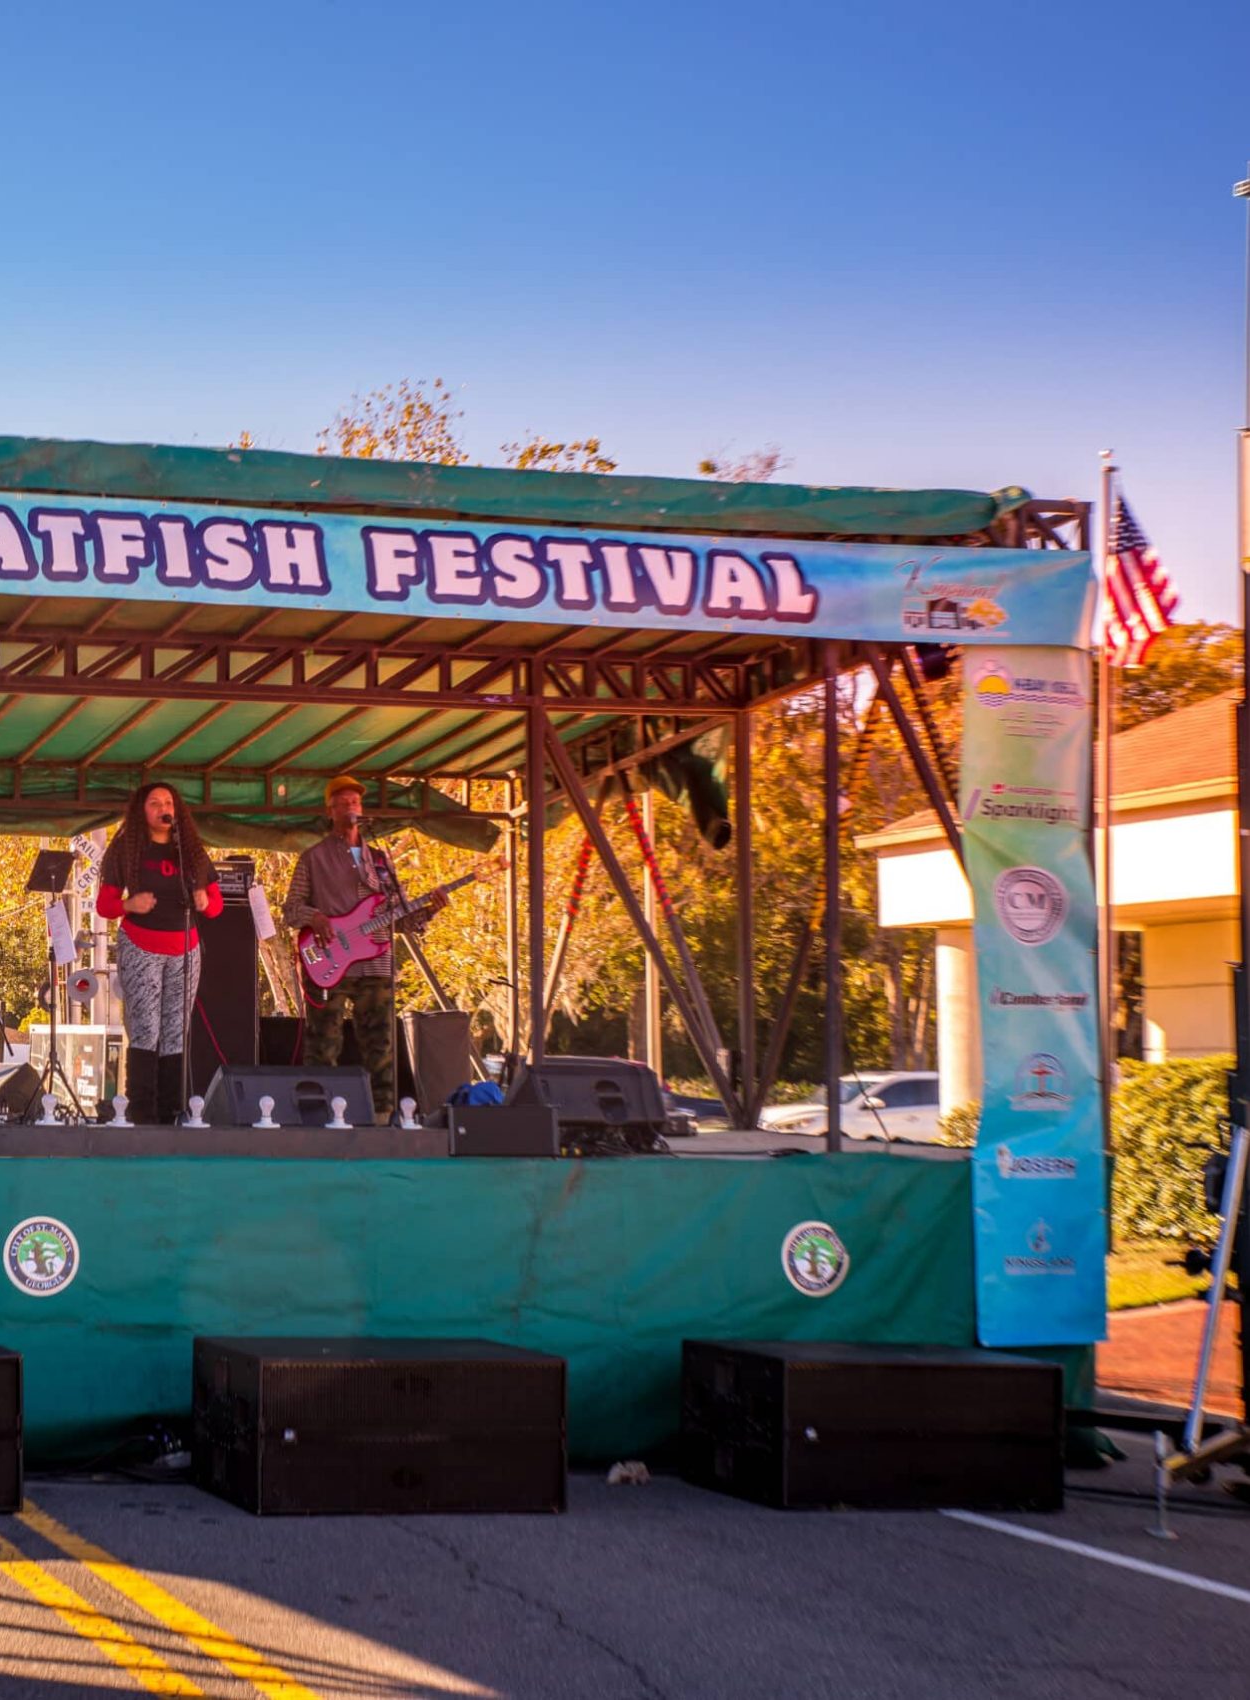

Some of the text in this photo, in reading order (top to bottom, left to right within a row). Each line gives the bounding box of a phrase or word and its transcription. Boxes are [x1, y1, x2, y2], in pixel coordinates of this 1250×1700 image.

[361, 526, 817, 623] FESTIVAL
[10, 1234, 23, 1257] CITY
[25, 1275, 65, 1291] GEORGIA
